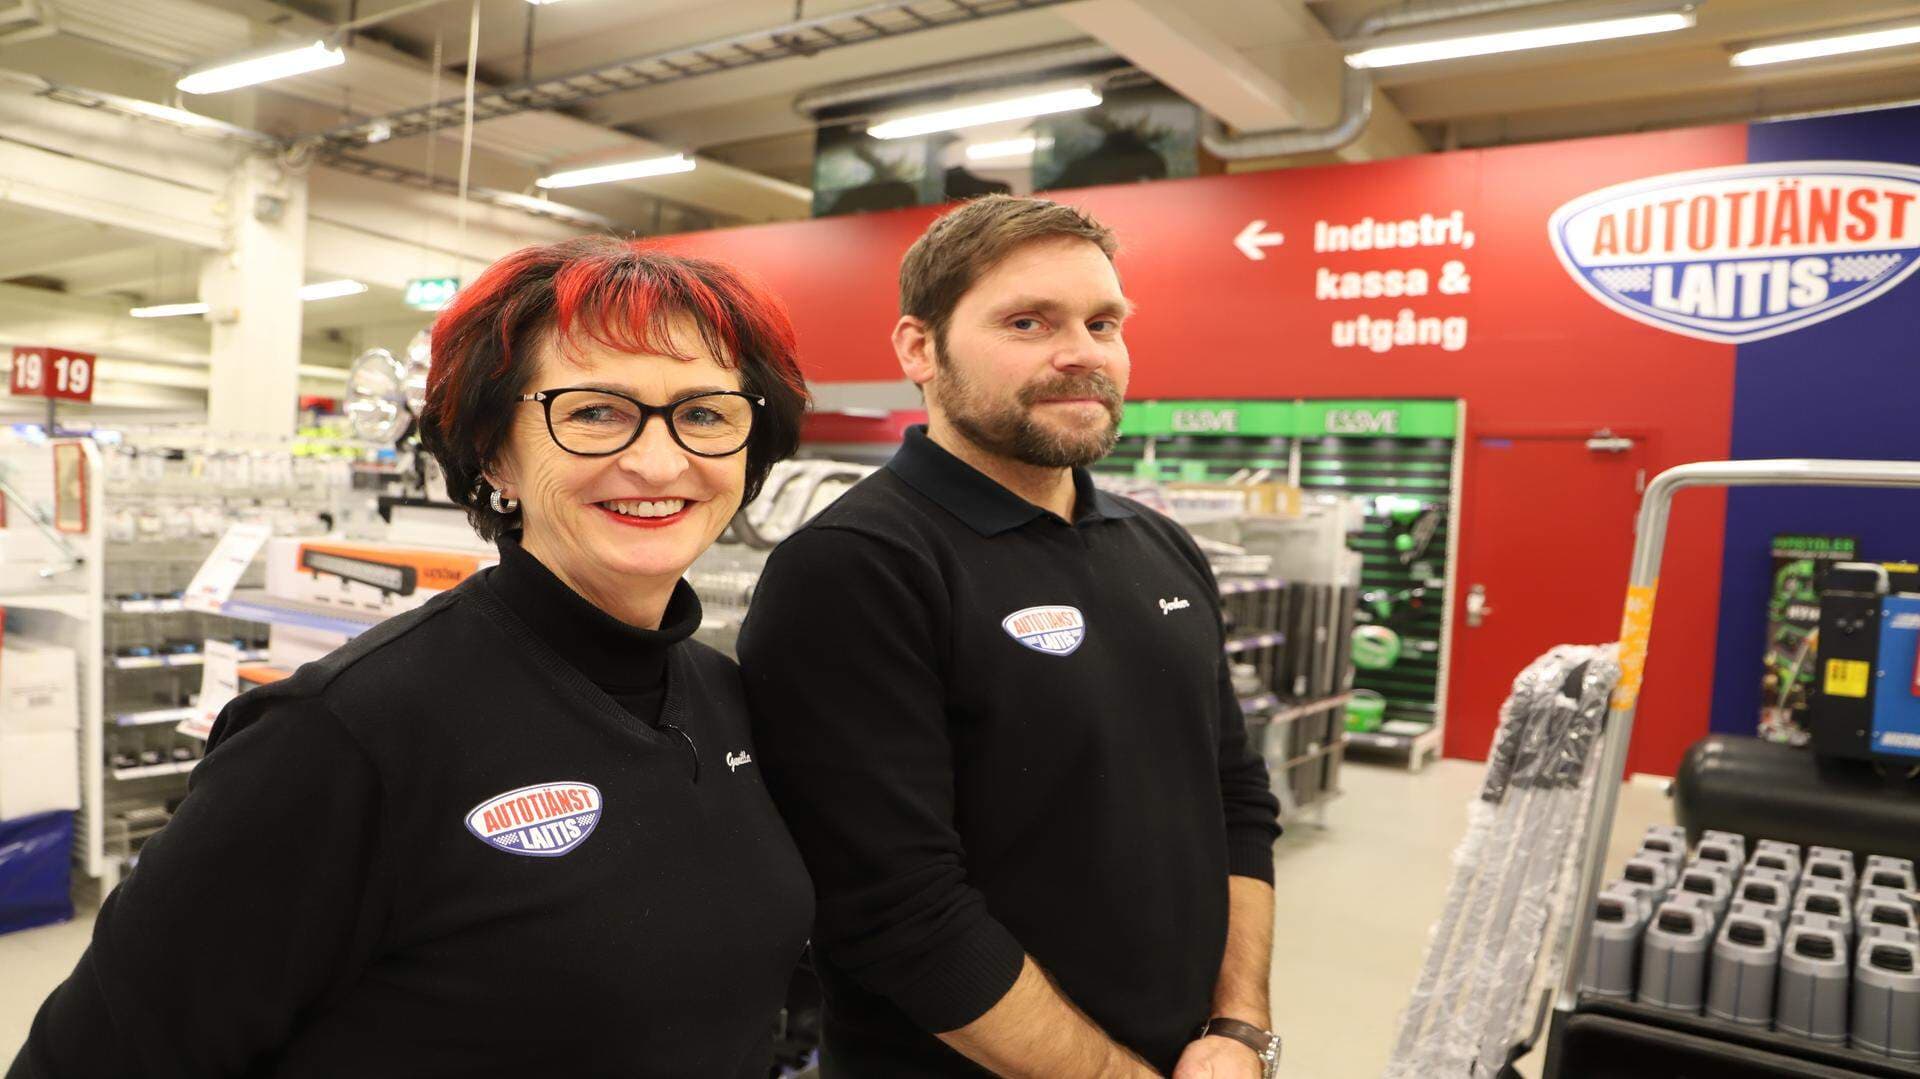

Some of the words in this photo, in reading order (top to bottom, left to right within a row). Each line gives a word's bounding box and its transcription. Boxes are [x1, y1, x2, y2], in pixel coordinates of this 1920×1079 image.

[1313, 210, 1476, 253] Industri,
[1592, 178, 1916, 256] AUTOTJÄNST
[1315, 267, 1429, 300] kassa
[1437, 259, 1471, 295] &
[1652, 256, 1830, 320] LAITIS
[1331, 308, 1468, 353] utgång
[15, 353, 42, 390] 19
[54, 356, 90, 394] 19
[1012, 610, 1080, 635] AUTOTJÄNST
[1037, 629, 1076, 650] LAITIS
[482, 788, 594, 834] AUTOTJÄNST
[518, 818, 583, 850] LAITIS
